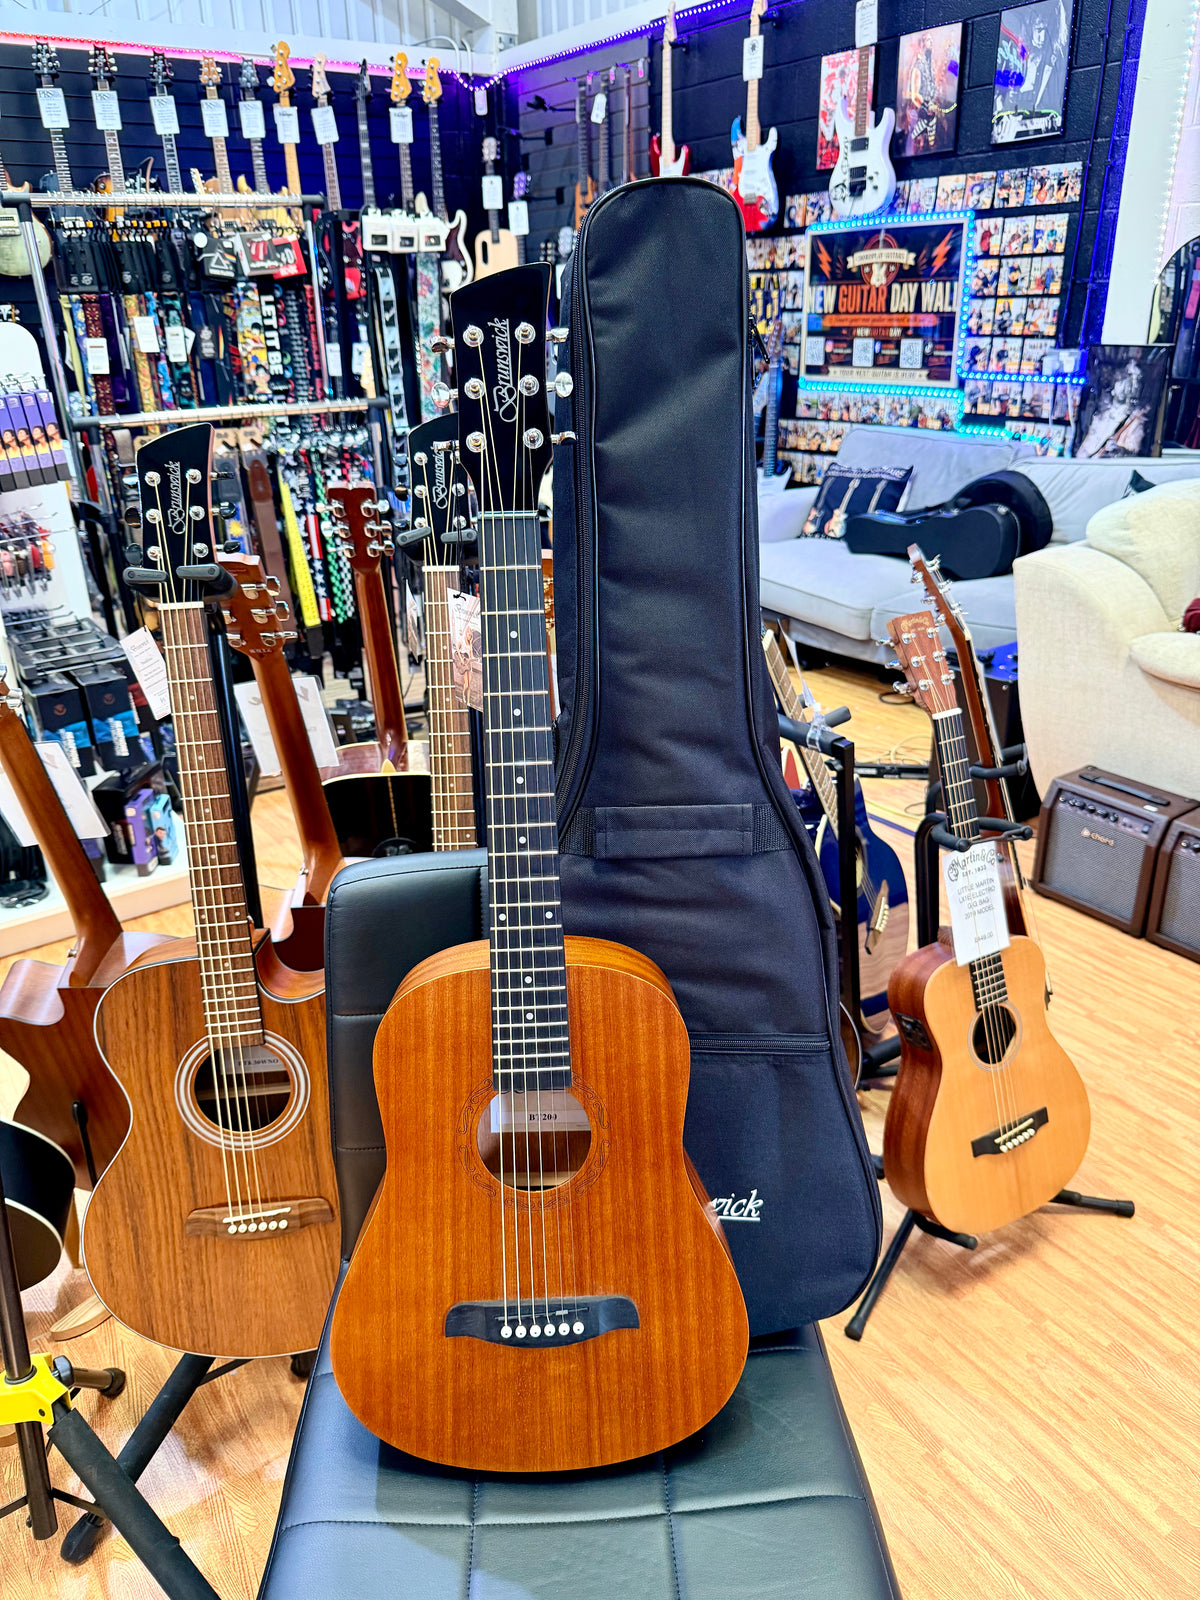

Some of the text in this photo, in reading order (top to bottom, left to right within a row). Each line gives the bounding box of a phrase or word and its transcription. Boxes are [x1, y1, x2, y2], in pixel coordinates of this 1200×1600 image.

[806, 281, 959, 313] NEW GUITAR DAY WALL
[260, 294, 278, 329] LET
[265, 330, 281, 351] IT
[267, 351, 284, 376] BE
[487, 317, 517, 423] Brunswick
[164, 460, 186, 535] Brunswick
[957, 878, 995, 895] LITTLE MARTIN
[977, 903, 995, 915] MODEL
[529, 1113, 557, 1121] BT200
